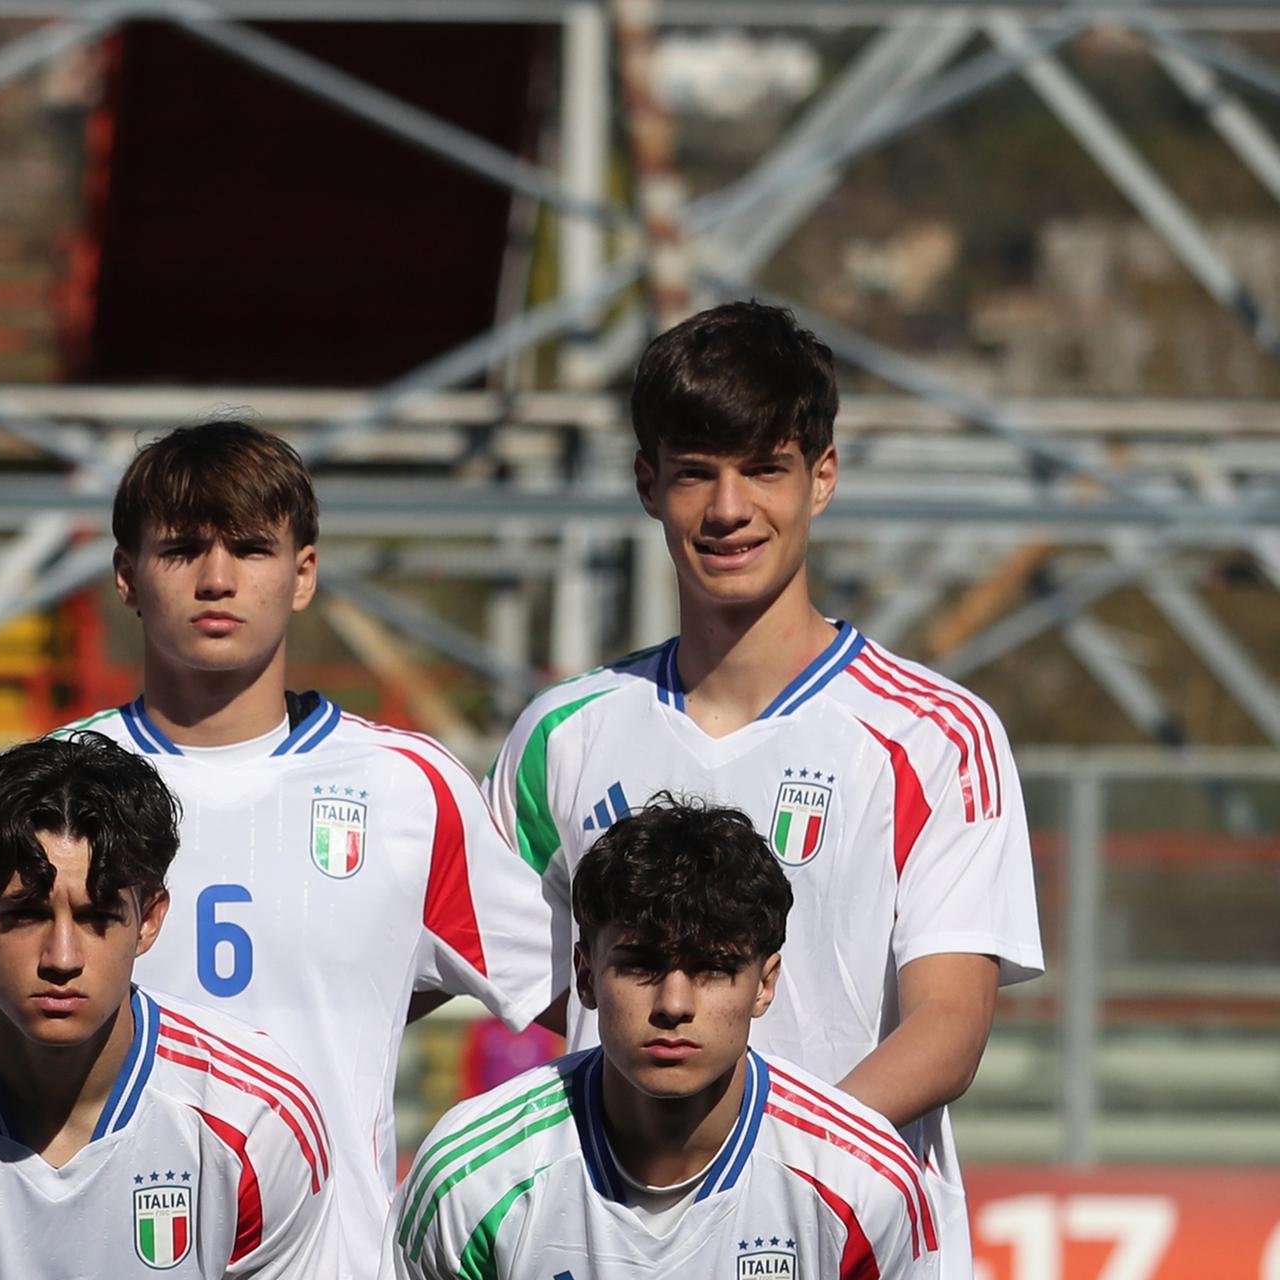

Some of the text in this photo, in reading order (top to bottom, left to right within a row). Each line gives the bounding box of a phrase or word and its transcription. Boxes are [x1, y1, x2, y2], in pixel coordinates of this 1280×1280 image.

[781, 787, 825, 808] ITALIA
[316, 803, 361, 823] ITALIA
[197, 884, 253, 997] 6
[138, 1192, 187, 1210] ITALIA
[742, 1259, 791, 1276] ITALIA
